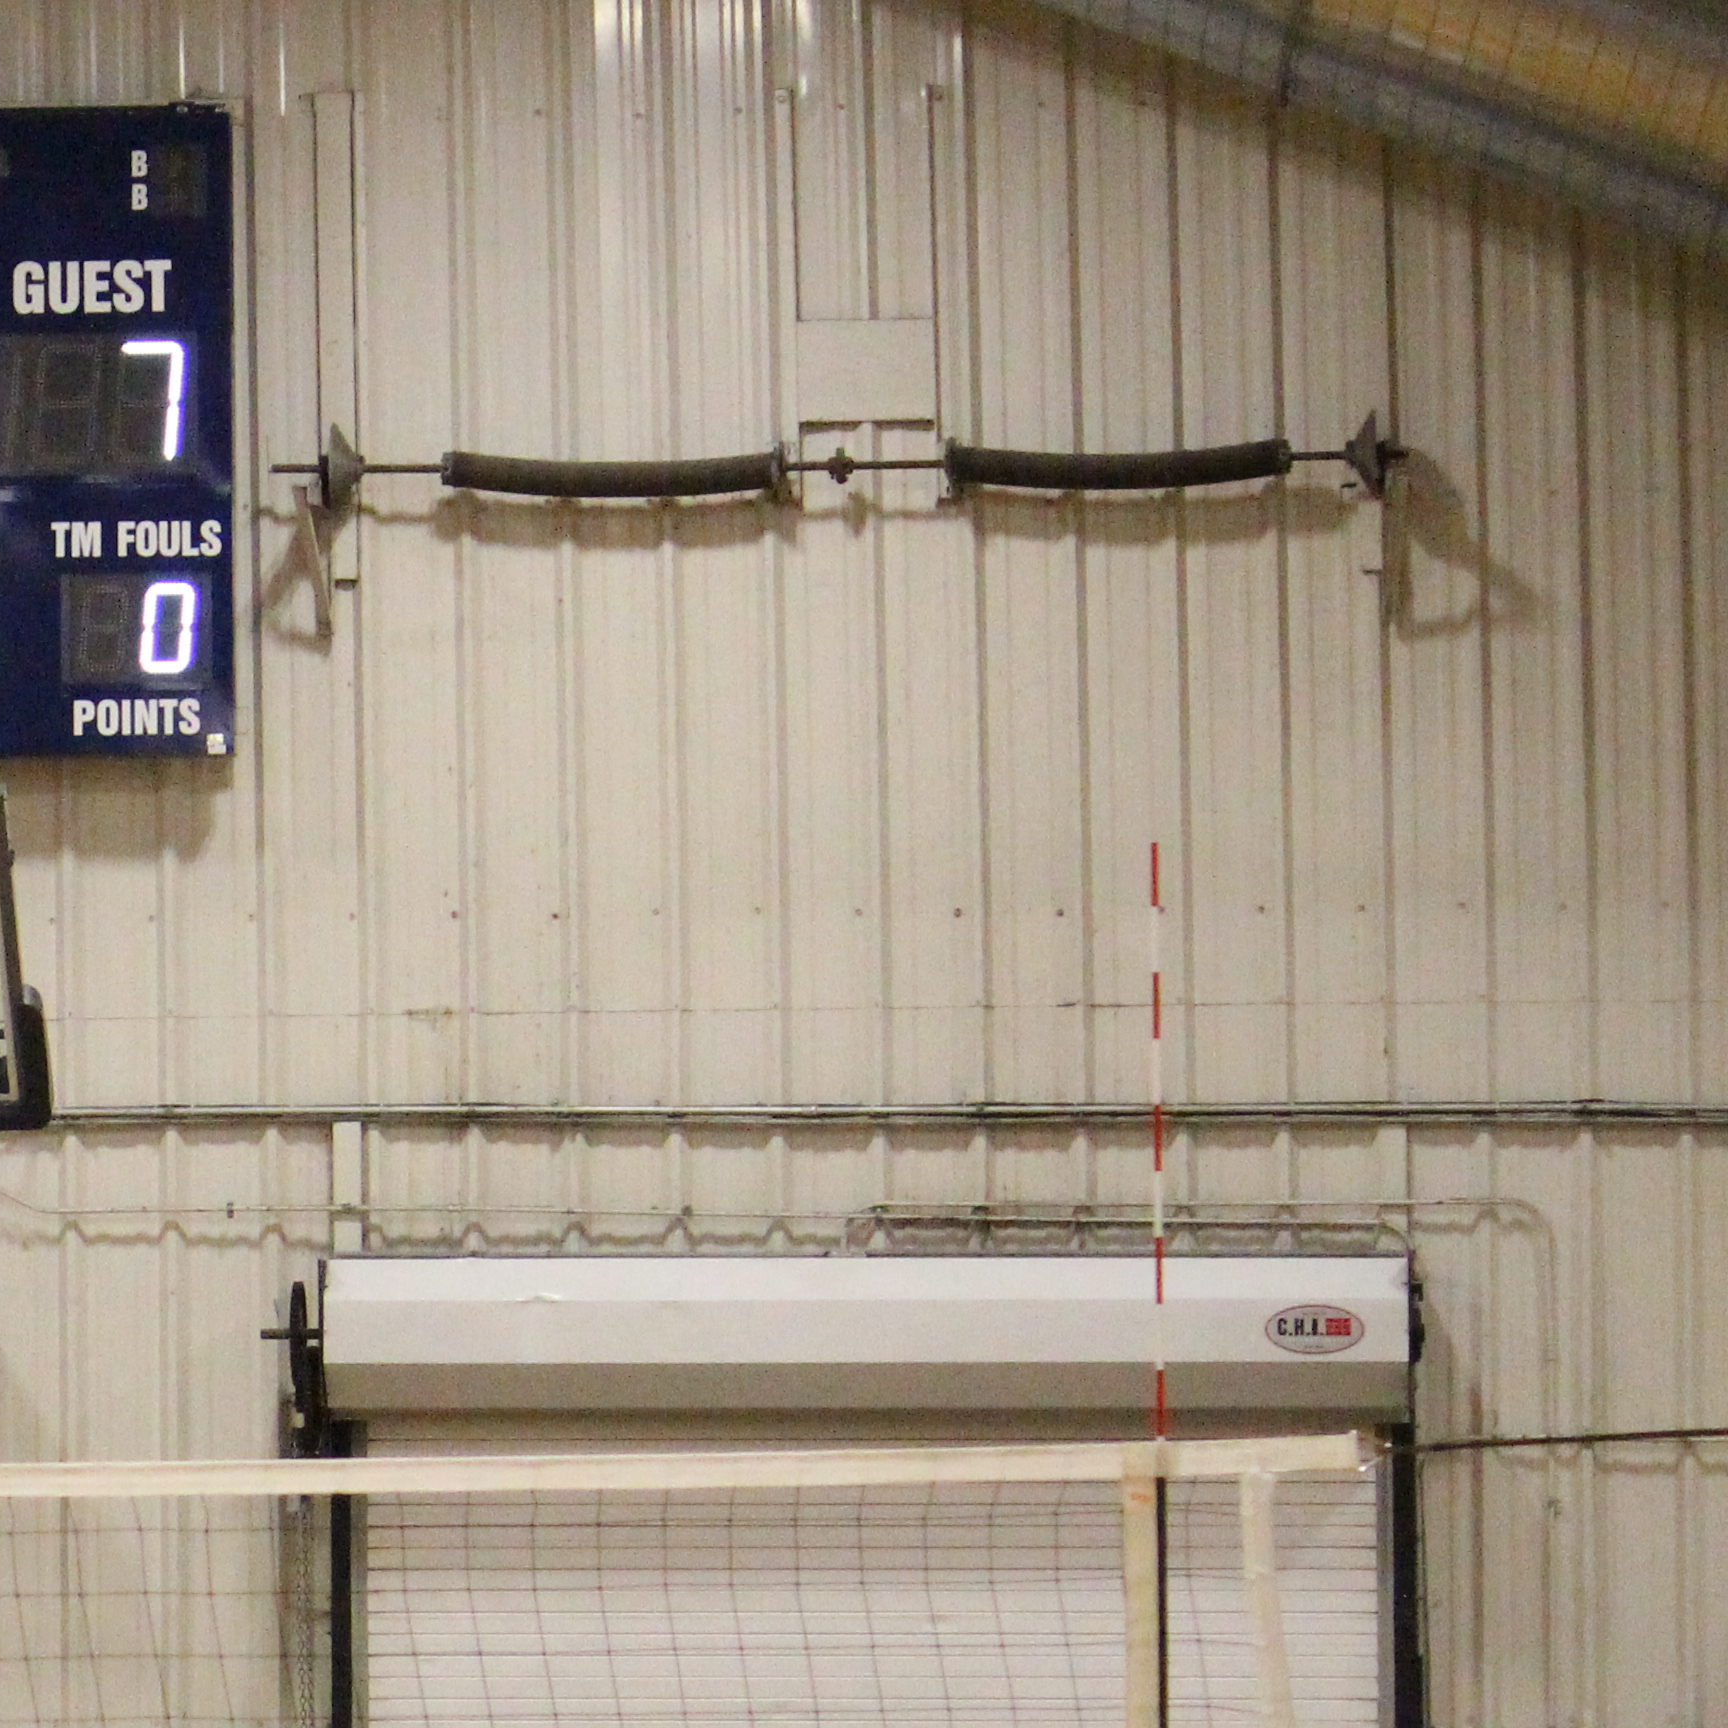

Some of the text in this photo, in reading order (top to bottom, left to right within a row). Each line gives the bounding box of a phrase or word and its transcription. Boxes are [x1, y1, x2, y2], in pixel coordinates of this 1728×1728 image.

[131, 150, 148, 177] B
[131, 184, 148, 210] B
[13, 259, 172, 314] GUEST
[122, 341, 185, 460] 7
[51, 520, 222, 557] TM FOULS
[139, 582, 196, 674] 0
[73, 698, 201, 736] POINTS
